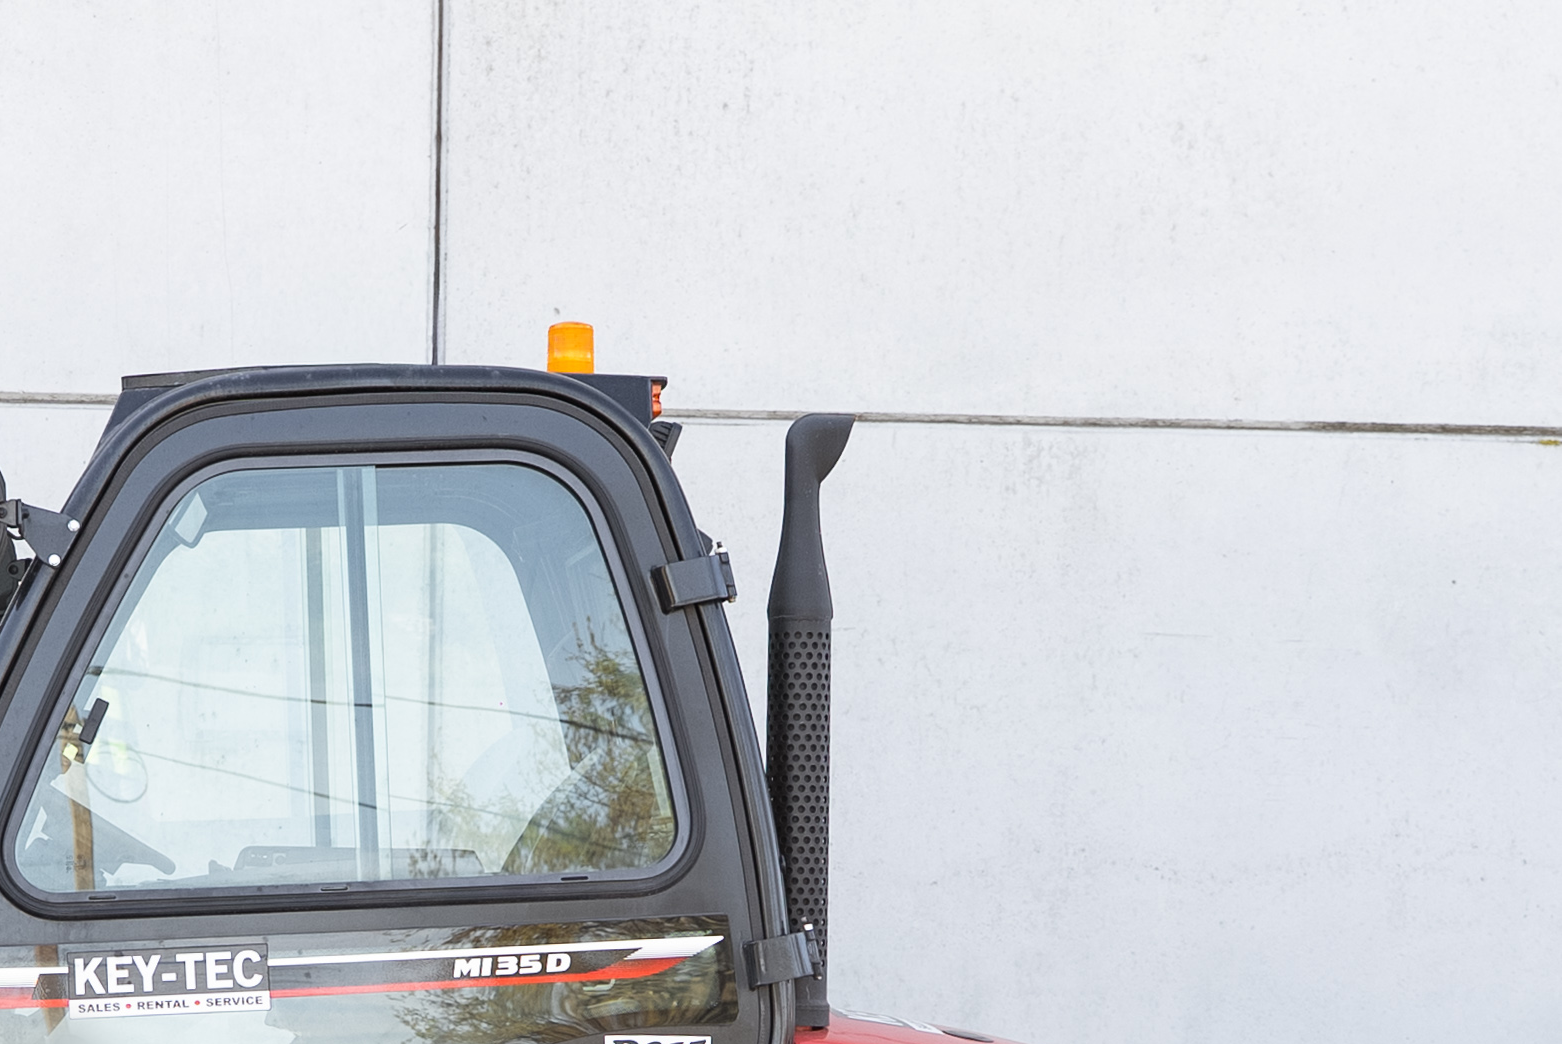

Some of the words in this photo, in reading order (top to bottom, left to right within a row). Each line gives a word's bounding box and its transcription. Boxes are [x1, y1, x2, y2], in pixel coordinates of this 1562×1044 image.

[74, 949, 264, 996] KEY-TEC
[78, 1003, 121, 1014] SALES
[137, 1000, 190, 1011] RENTAL
[206, 996, 263, 1007] SERVICE
